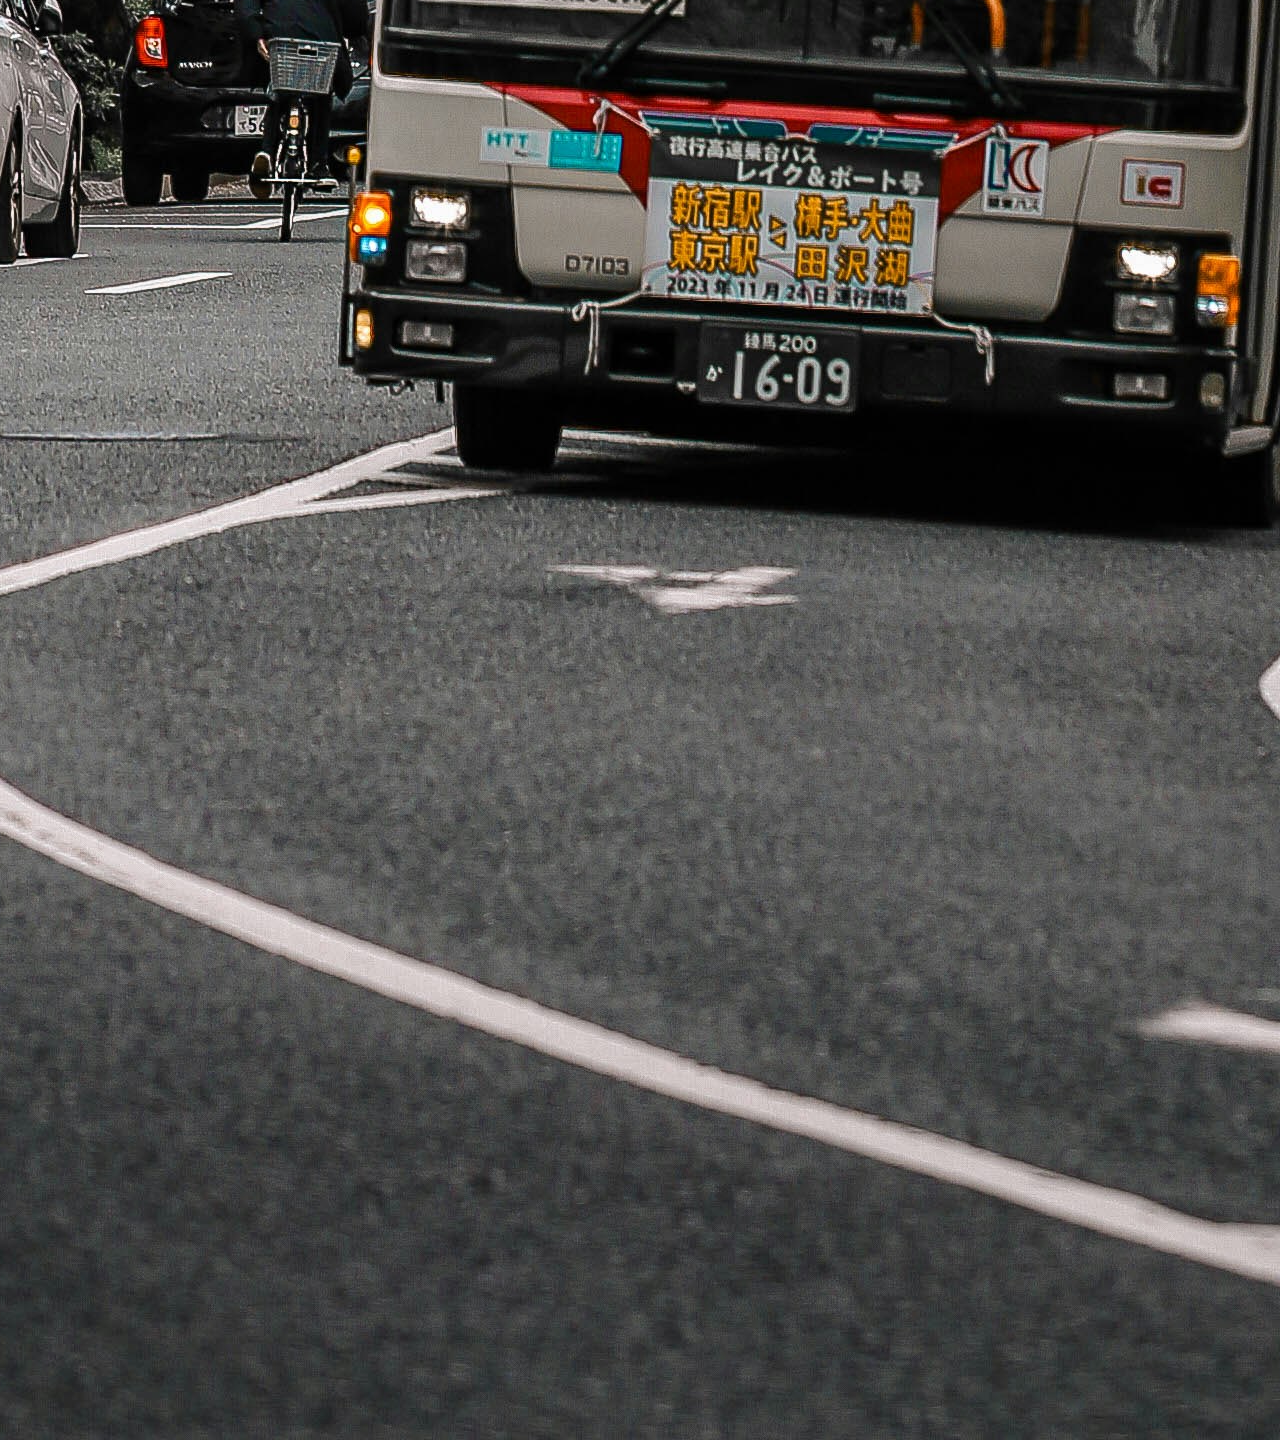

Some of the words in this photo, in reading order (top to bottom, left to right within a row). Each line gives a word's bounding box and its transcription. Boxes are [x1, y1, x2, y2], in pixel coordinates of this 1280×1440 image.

[487, 132, 529, 148] HTT
[670, 181, 764, 230] 新宿駅
[668, 229, 760, 277] 東京駅
[794, 242, 911, 287] 田沢湖
[733, 350, 851, 406] 16-09
